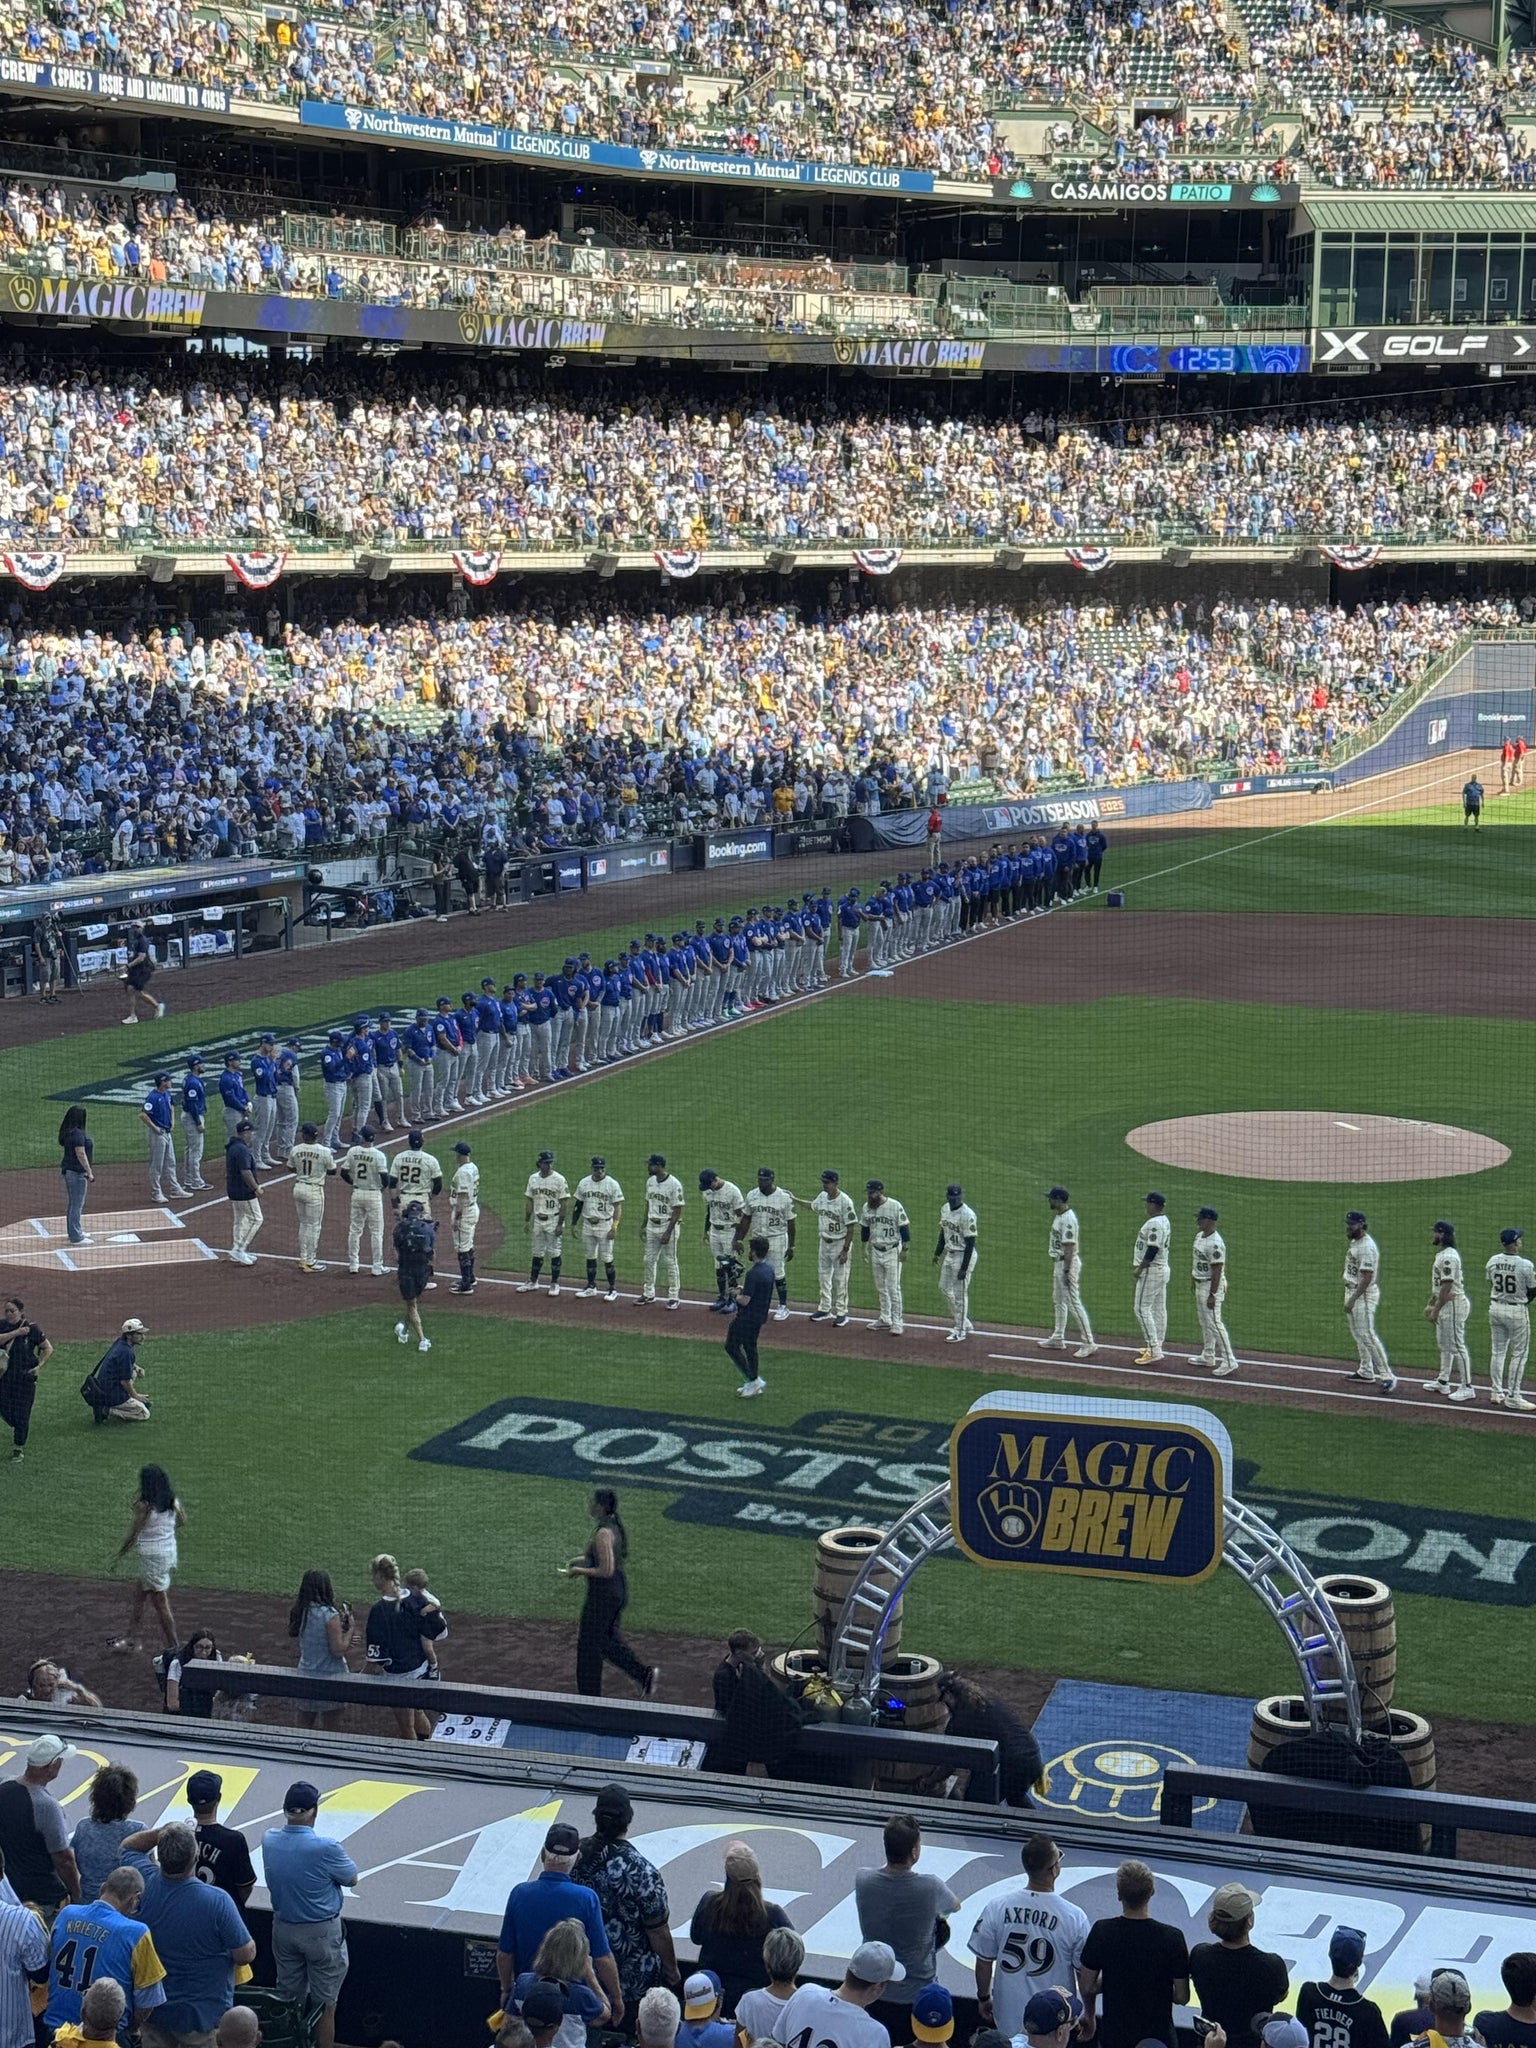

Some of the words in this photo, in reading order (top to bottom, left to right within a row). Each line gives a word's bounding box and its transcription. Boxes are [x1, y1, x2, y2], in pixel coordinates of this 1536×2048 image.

[98, 73, 124, 96] ISSUE
[126, 79, 144, 98] AND
[146, 80, 185, 104] LOCATION
[187, 86, 199, 107] TO
[363, 113, 451, 141] Northwestern
[453, 126, 501, 148] Mutual
[510, 134, 560, 156] LEGENDS
[562, 141, 590, 160] CLUB
[659, 154, 751, 176] Northwestern
[754, 162, 804, 180] Mutual
[814, 166, 868, 186] LEGENDS
[870, 172, 900, 188] CLUB
[1050, 182, 1168, 201] CASAMIGOS
[1180, 185, 1224, 199] PATIO
[35, 276, 147, 320] MAGIC
[145, 287, 207, 324] BREW
[478, 314, 561, 348] MAGIC
[559, 320, 607, 352] BREW
[853, 337, 939, 367] MAGIC
[936, 340, 986, 369] BREW
[1319, 331, 1370, 361] X
[1382, 335, 1489, 356] GOLF
[1179, 347, 1235, 371] 12:53
[1477, 713, 1527, 723] Booking.com
[1010, 799, 1100, 827] POSTSEASON
[1101, 799, 1126, 813] 2025
[708, 841, 767, 859] Booking.com
[302, 1159, 312, 1176] 11
[356, 1163, 367, 1180] 2
[400, 1165, 421, 1184] 22
[545, 1199, 555, 1209] 10
[723, 1211, 730, 1221] 3
[768, 1217, 780, 1227] 23
[828, 1222, 841, 1233] 60
[882, 1227, 895, 1238] 70
[1495, 1263, 1517, 1273] MYERS
[1493, 1273, 1517, 1294] 36
[988, 1433, 1195, 1493] MAGIC
[1040, 1486, 1184, 1562] BREW
[367, 1644, 381, 1658] 53
[1003, 1906, 1059, 1932] AXFORD
[1000, 1932, 1057, 1977] 59
[54, 1938, 99, 1995] 41
[1314, 2007, 1354, 2030] FIELDER
[1313, 2020, 1351, 2048] 28
